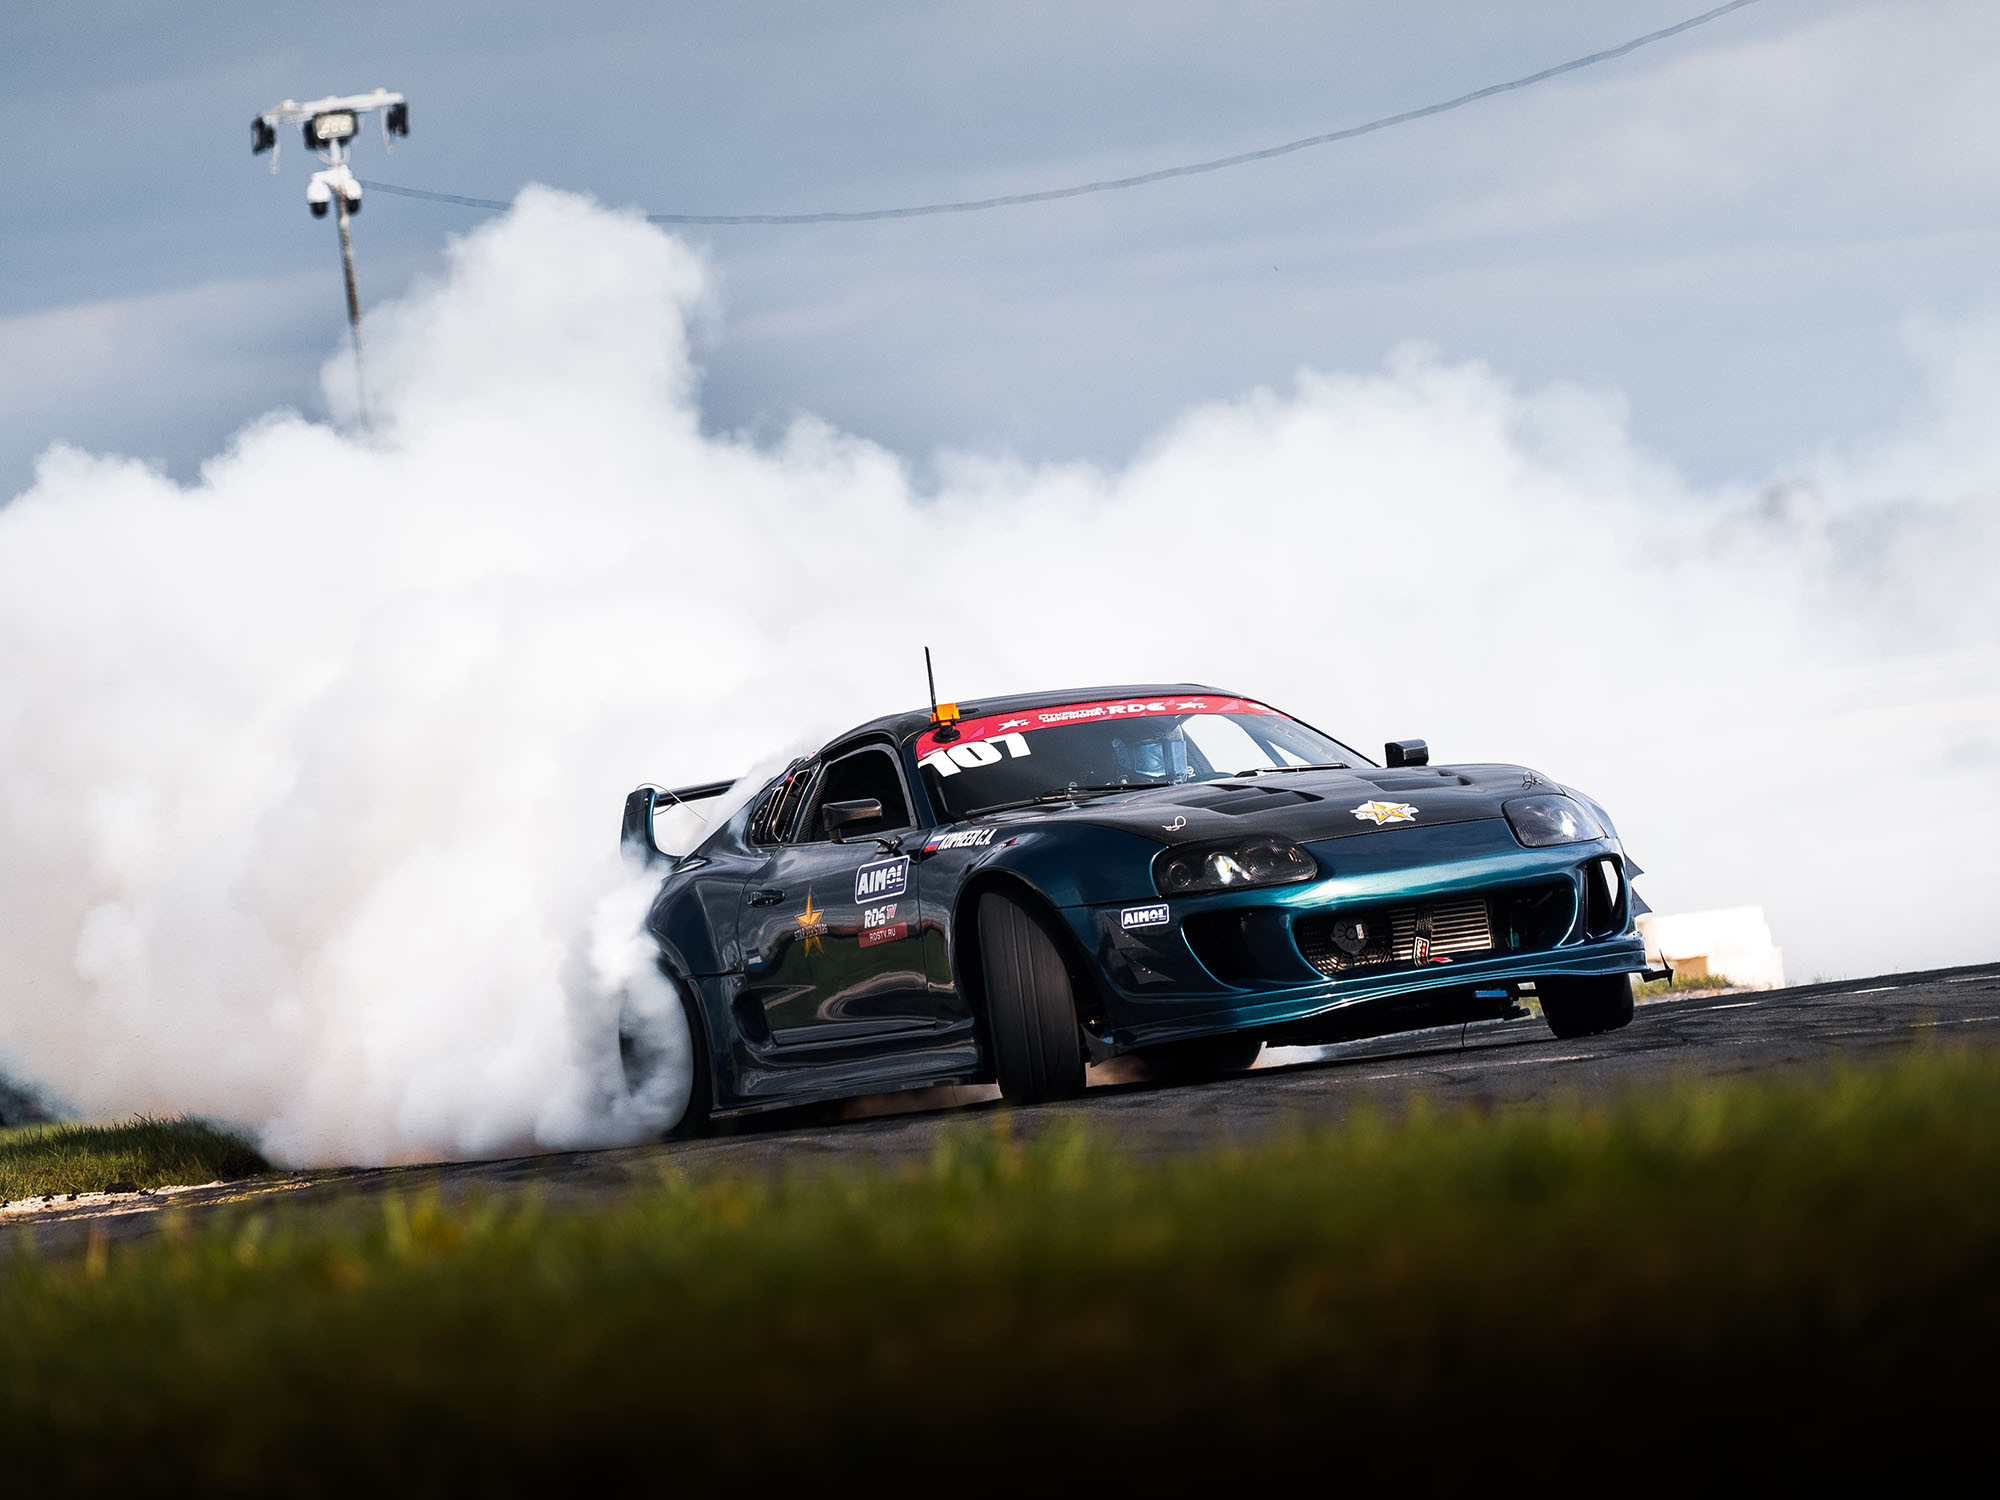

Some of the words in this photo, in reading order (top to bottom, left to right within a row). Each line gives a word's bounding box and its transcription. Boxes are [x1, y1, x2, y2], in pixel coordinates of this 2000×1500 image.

[918, 732, 1031, 778] 101
[857, 865, 904, 895] AIMOL
[1124, 909, 1166, 924] AIMOL
